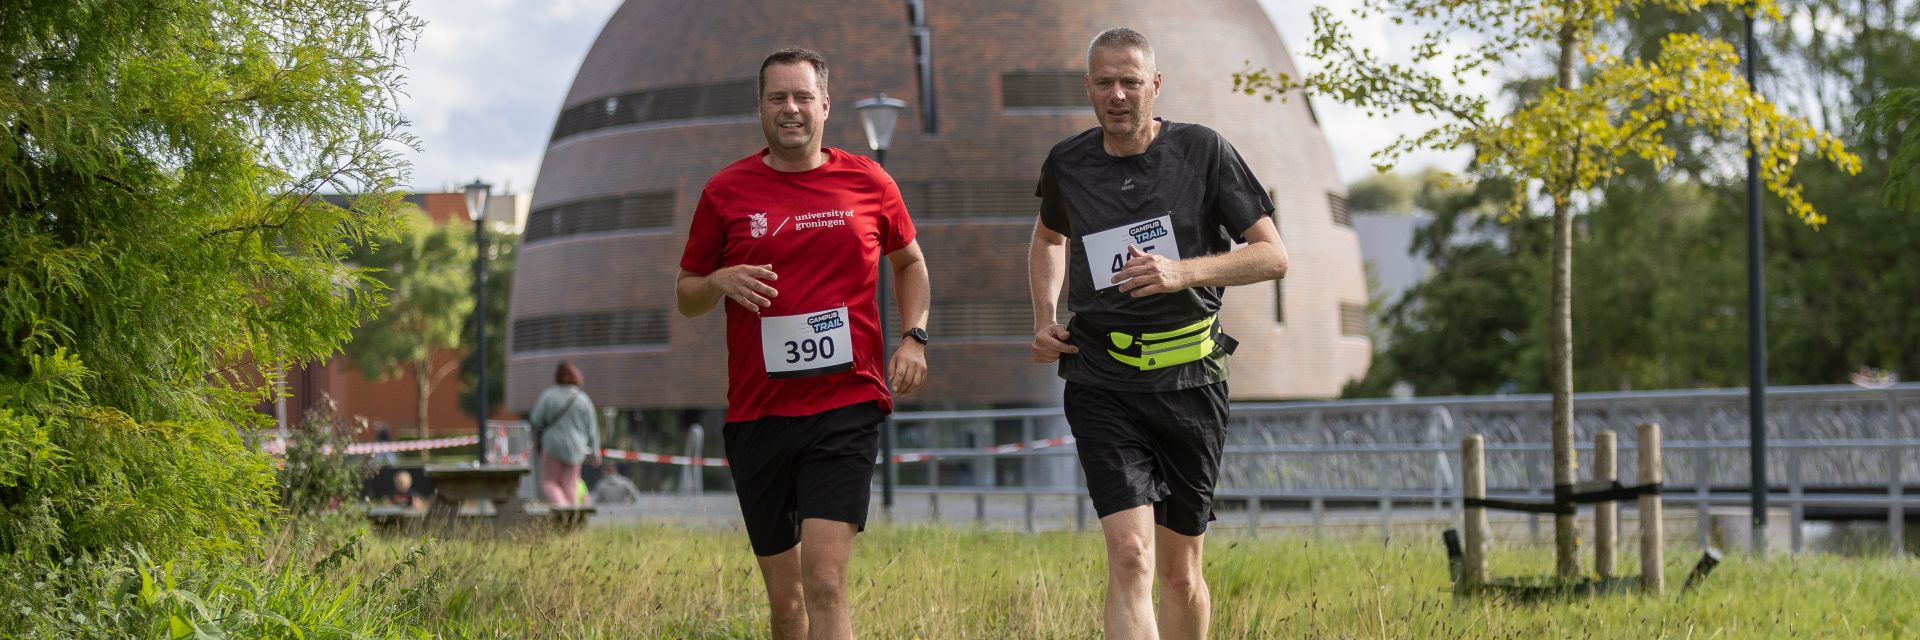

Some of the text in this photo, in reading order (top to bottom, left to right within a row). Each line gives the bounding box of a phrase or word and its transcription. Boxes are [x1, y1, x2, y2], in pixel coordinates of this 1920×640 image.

[795, 209, 855, 221] university of
[795, 219, 845, 231] groningen
[1130, 221, 1160, 235] CAMPUS
[1135, 227, 1167, 243] TRAIL
[808, 312, 838, 324] CAMPUS
[814, 318, 843, 332] TRAIL
[784, 335, 835, 364] 390
